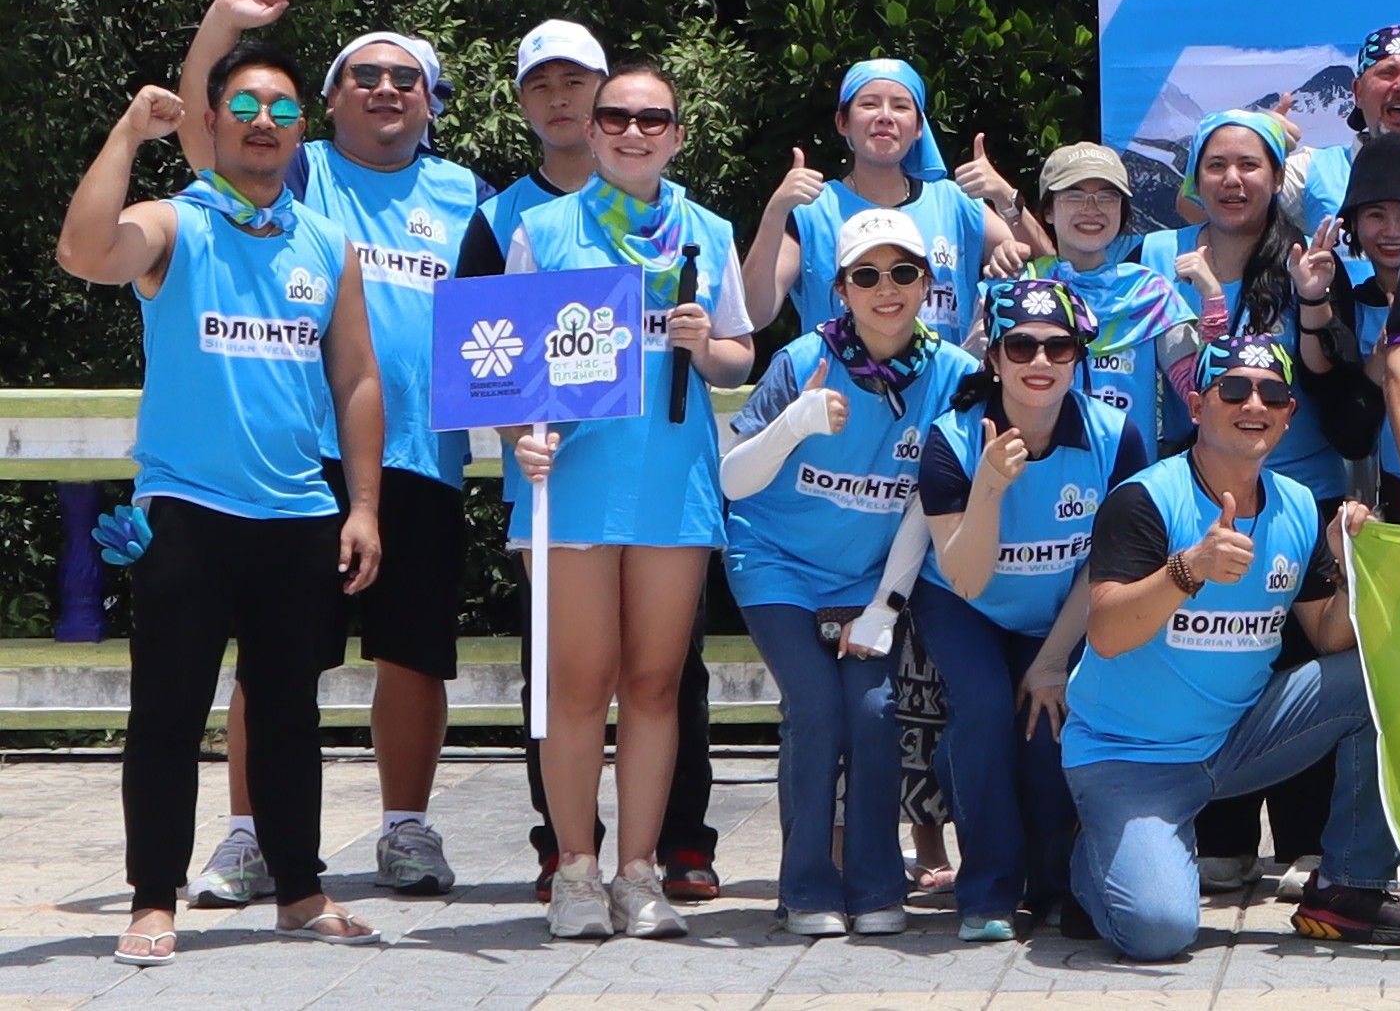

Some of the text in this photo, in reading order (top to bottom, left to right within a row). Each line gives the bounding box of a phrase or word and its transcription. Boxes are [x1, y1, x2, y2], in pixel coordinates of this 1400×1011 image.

[356, 247, 447, 280] ЛОНТЁР
[998, 537, 1092, 562] ЛОНТЁР
[1172, 634, 1232, 646] SIBERIAN
